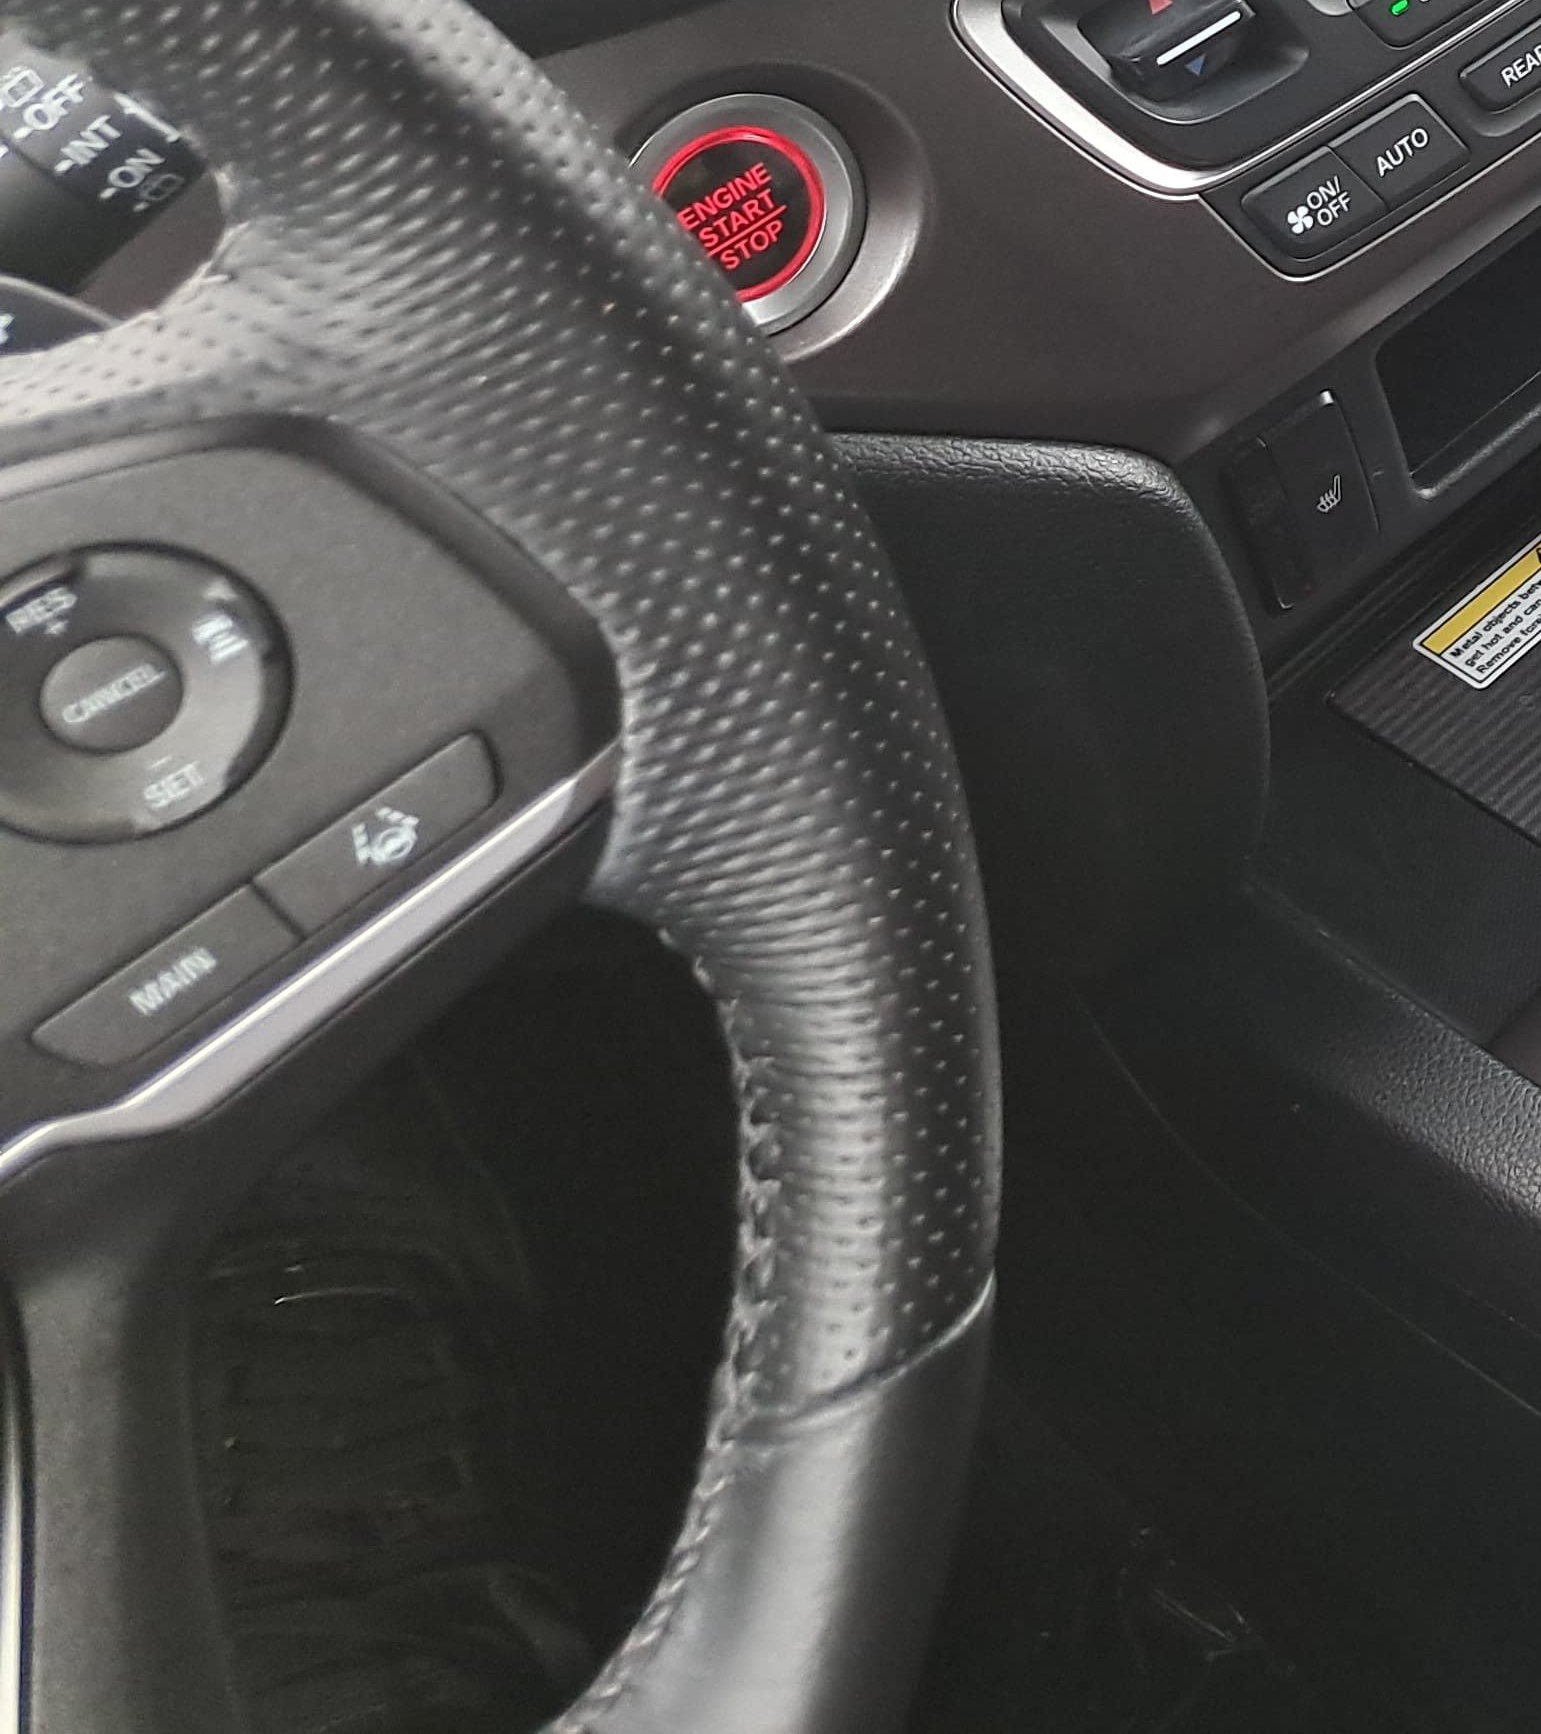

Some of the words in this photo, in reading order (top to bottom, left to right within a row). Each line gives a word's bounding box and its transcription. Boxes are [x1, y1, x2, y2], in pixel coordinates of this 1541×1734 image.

[1375, 127, 1431, 178] AUTO
[677, 162, 772, 231] ENGINE
[1306, 175, 1342, 212] ON/
[1317, 191, 1352, 228] OFF
[699, 191, 776, 249] START
[720, 219, 784, 271] STOP
[1449, 632, 1482, 658] Metal
[1482, 599, 1520, 631] objects
[1464, 649, 1483, 667] get
[1482, 633, 1502, 650] hot
[1502, 615, 1523, 633] and
[1475, 637, 1521, 674] Remove
[127, 946, 218, 1017] MAIN
